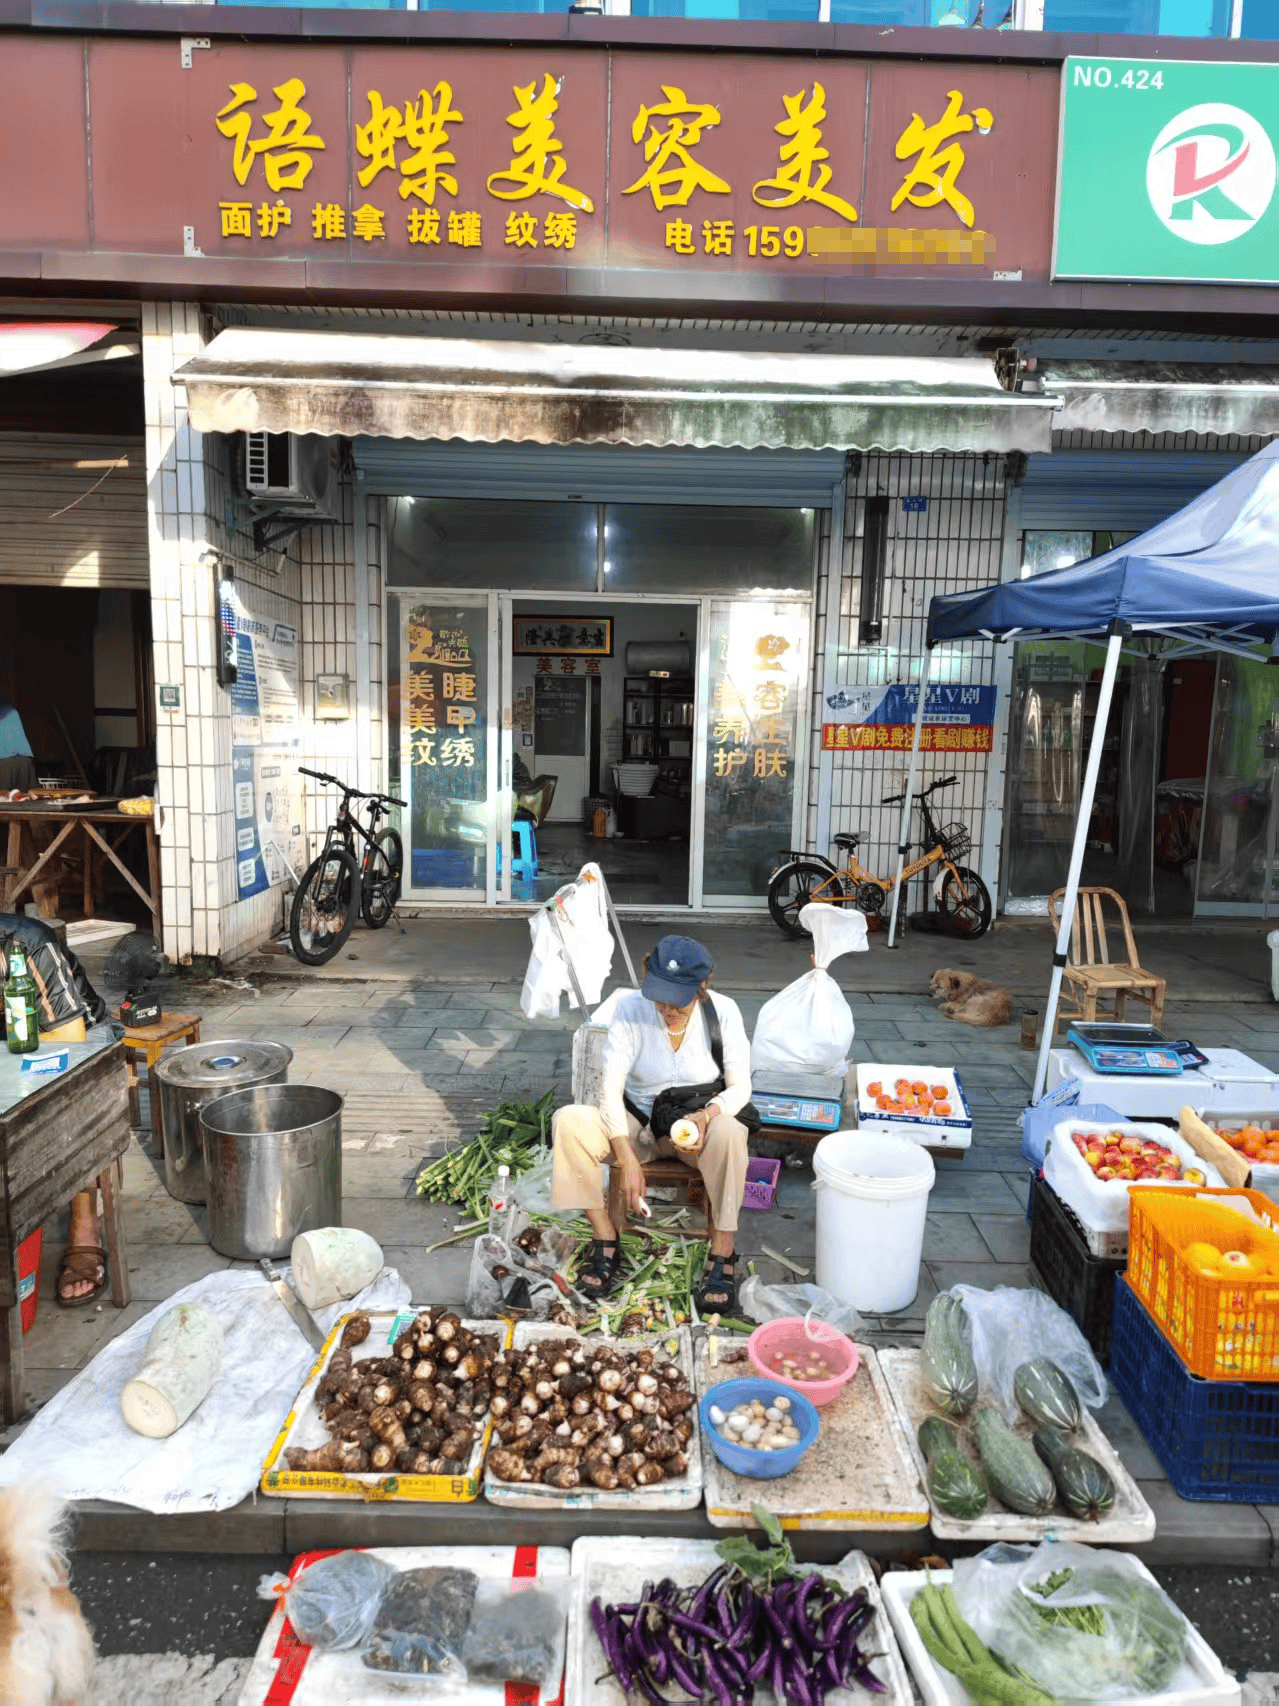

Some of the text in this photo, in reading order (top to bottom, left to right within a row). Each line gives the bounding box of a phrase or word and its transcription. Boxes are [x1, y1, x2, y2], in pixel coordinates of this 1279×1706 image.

[1073, 65, 1164, 91] NO.424
[216, 73, 994, 228] 语蝶美容美发
[219, 201, 578, 250] 面护 推拿 拔罐 纹绣
[665, 217, 735, 256] 电话
[536, 656, 600, 673] 美容室
[408, 670, 478, 702] 美睫
[407, 704, 477, 734] 美甲
[713, 748, 789, 777] 护肤
